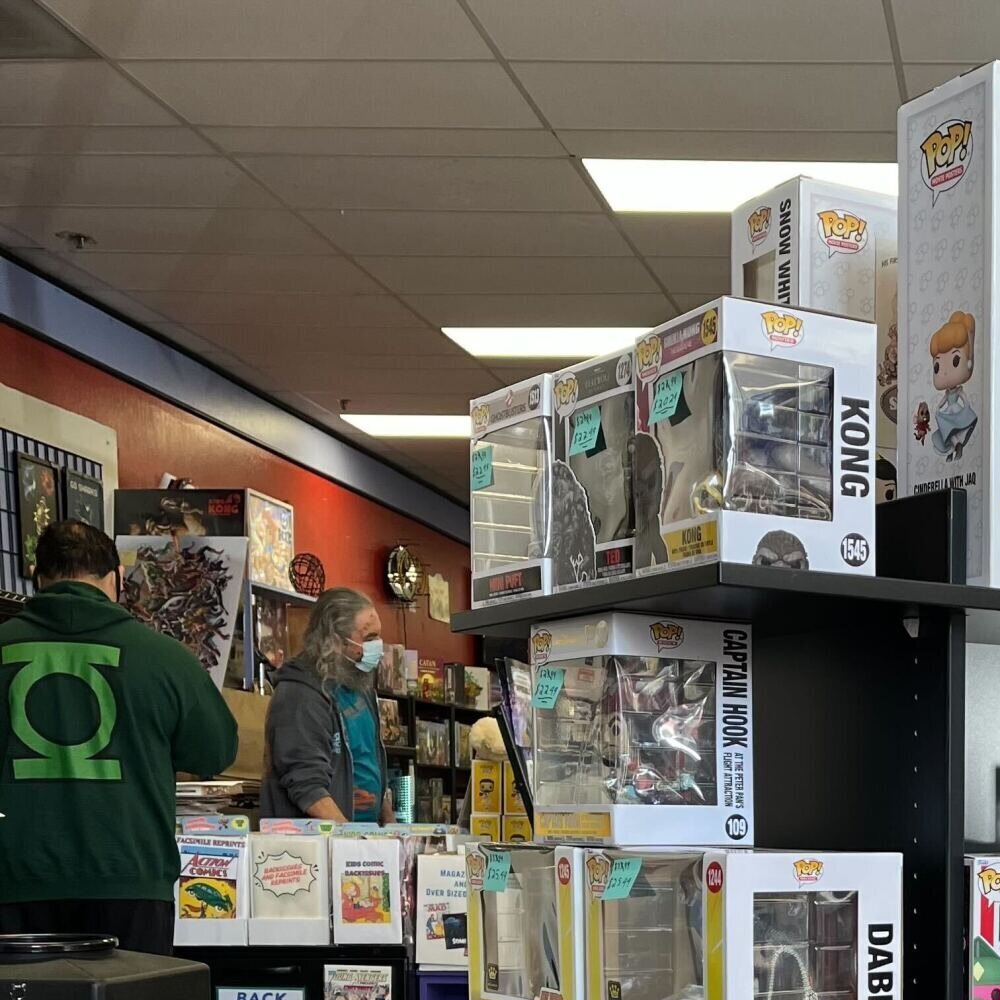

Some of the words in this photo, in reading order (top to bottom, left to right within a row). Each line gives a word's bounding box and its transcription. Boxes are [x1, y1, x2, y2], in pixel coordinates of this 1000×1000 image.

[920, 119, 972, 175] POP!
[779, 198, 791, 256] SNOW
[816, 209, 868, 243] POP!
[761, 311, 804, 337] POP!
[490, 404, 527, 425] GHOSTBUSTERS
[841, 396, 870, 498] KONG
[682, 525, 702, 544] KONG
[841, 538, 868, 561] 1545
[650, 621, 684, 640] POP!
[723, 629, 748, 699] CAPTAIN
[722, 703, 748, 749] HOOK
[723, 752, 733, 771] FLIGHT
[724, 772, 732, 807] ATTRACTION
[735, 771, 744, 790] PETER
[727, 818, 746, 836] 109
[189, 868, 228, 878] COMICS
[362, 860, 385, 868] COMIC
[792, 860, 825, 876] POP!
[707, 870, 722, 883] 1244
[426, 888, 445, 897] OVER
